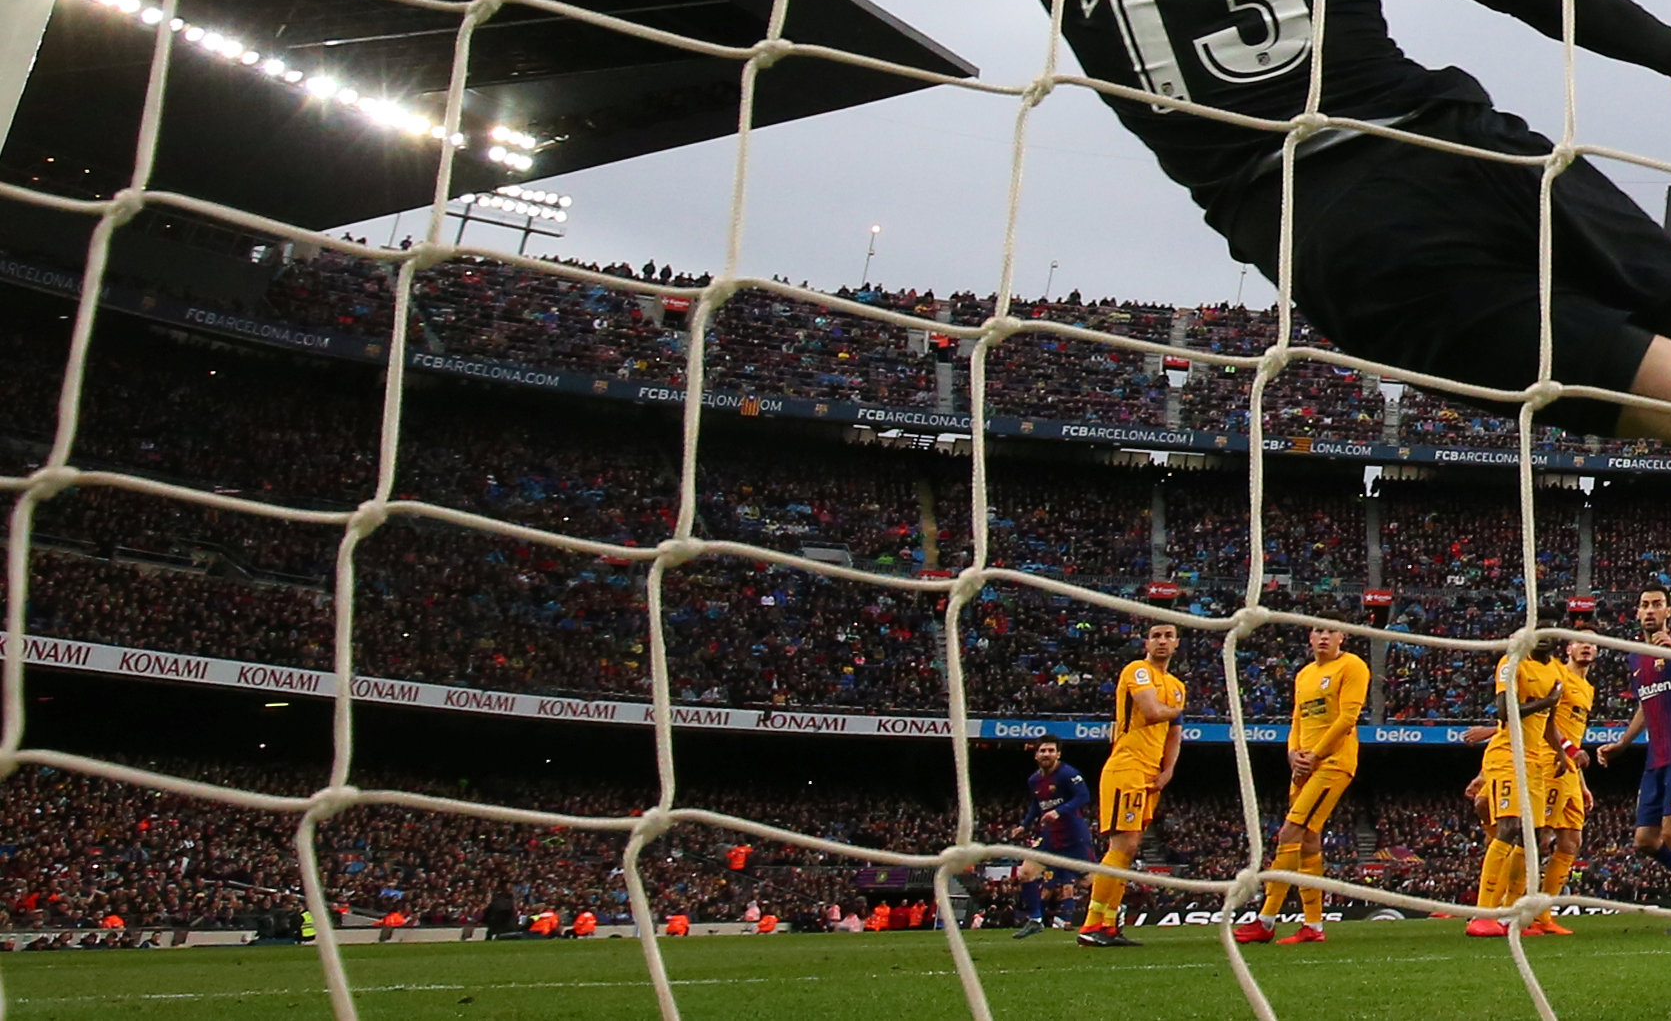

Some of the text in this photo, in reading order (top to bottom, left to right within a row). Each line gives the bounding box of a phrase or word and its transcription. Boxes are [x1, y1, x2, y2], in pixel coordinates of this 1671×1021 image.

[412, 352, 560, 388] FCBARCELONA.COM
[1062, 425, 1187, 444] FCBARCELONA.COM
[119, 651, 209, 679] KONAMI
[237, 665, 320, 693] KONAMI
[444, 689, 517, 713] KONAMI
[537, 698, 617, 720] KONAMI
[994, 722, 1048, 738] beko
[1075, 723, 1110, 739] bek
[1375, 728, 1422, 743] beko
[1123, 792, 1143, 810] 14
